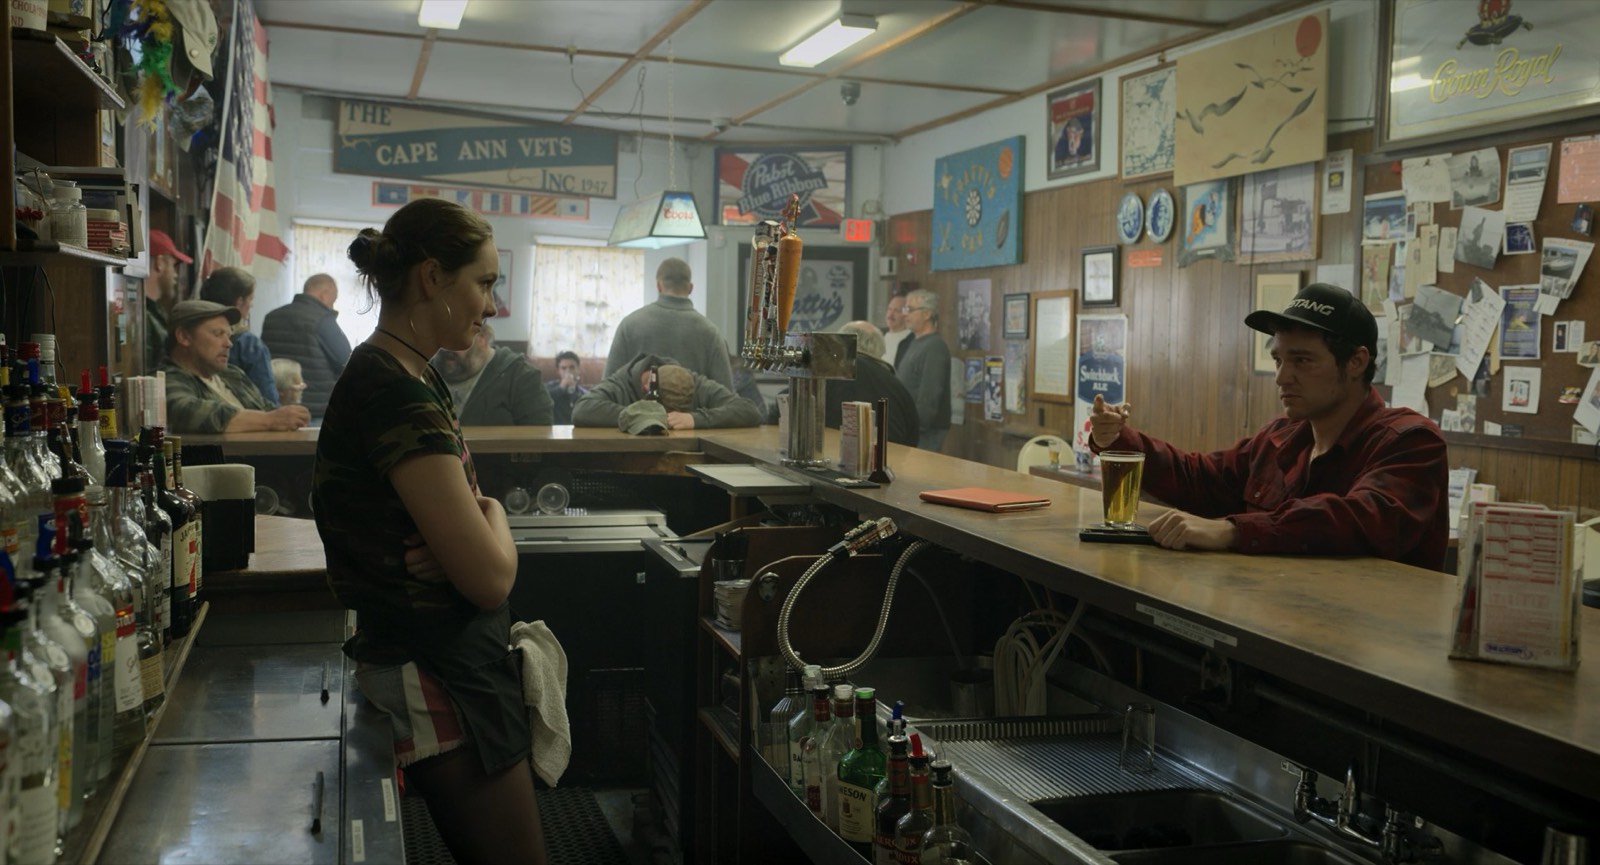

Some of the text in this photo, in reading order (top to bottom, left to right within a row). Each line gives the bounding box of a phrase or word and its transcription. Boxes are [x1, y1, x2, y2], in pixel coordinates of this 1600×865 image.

[1428, 43, 1563, 103] Crown Royal
[343, 102, 392, 127] THE
[375, 136, 574, 166] CAPE ANN VETS
[580, 178, 609, 193] 1947
[755, 159, 796, 189] Pabst
[739, 176, 825, 213] Blue Ribbon
[662, 207, 695, 221] Coors
[1092, 382, 1109, 392] ALE
